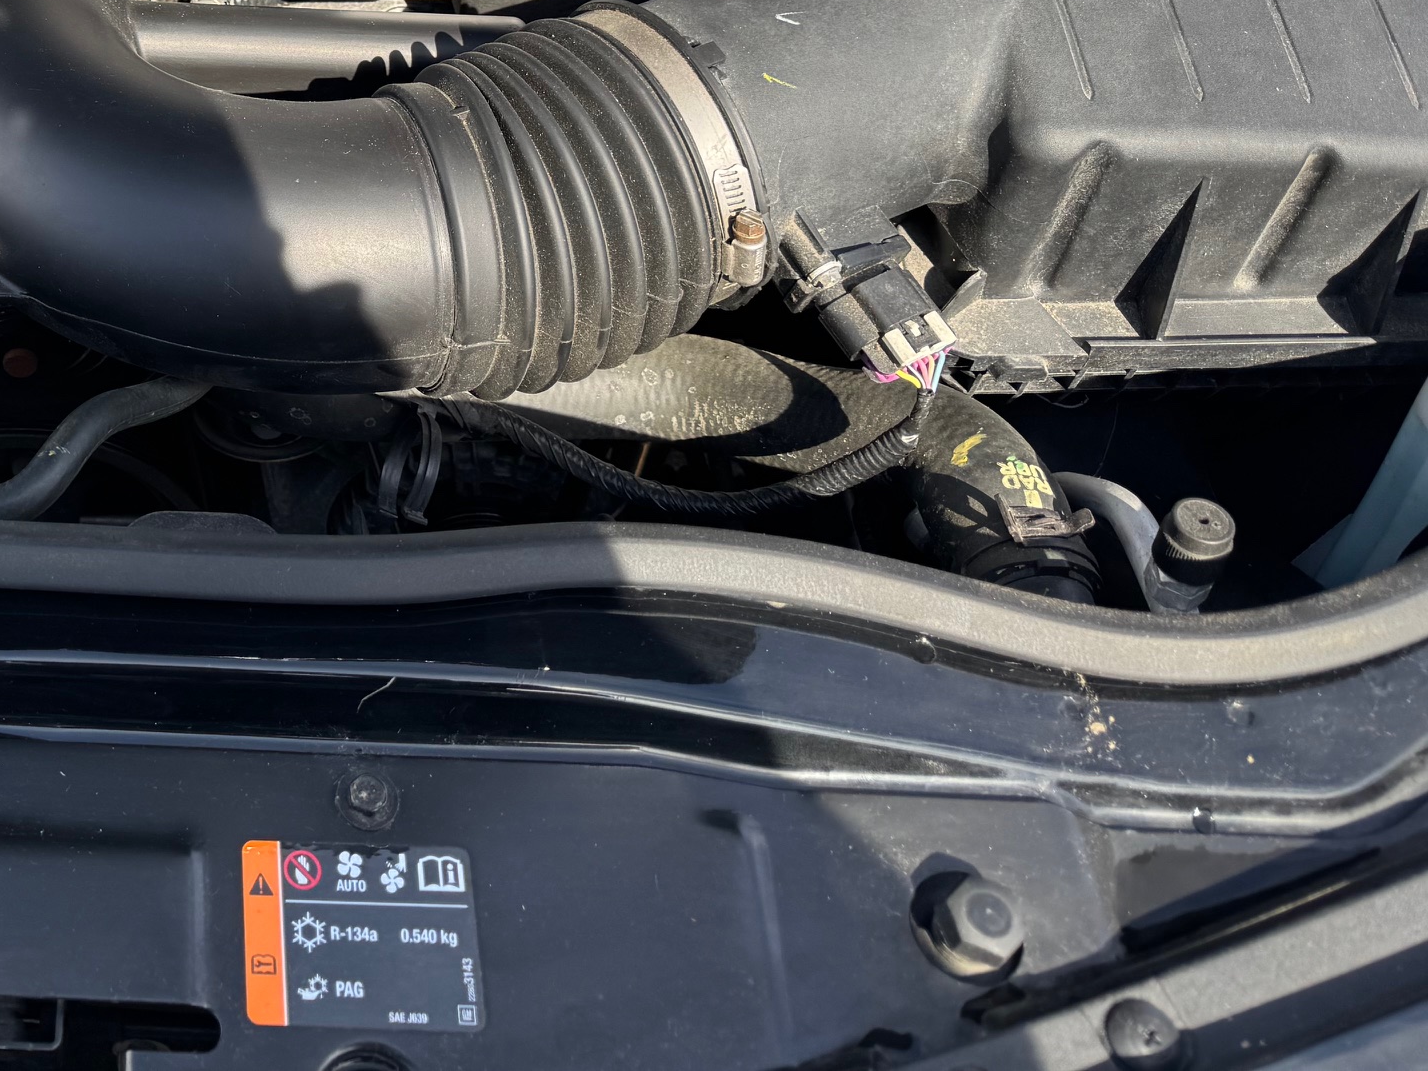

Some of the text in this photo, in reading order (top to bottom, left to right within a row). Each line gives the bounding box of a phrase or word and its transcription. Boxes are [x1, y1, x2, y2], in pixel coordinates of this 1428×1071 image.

[1001, 474, 1056, 499] RAD
[336, 878, 367, 893] AUTO
[329, 925, 459, 948] R-134a 0.540 kg
[335, 980, 365, 999] PAG
[388, 1011, 406, 1024] SAE
